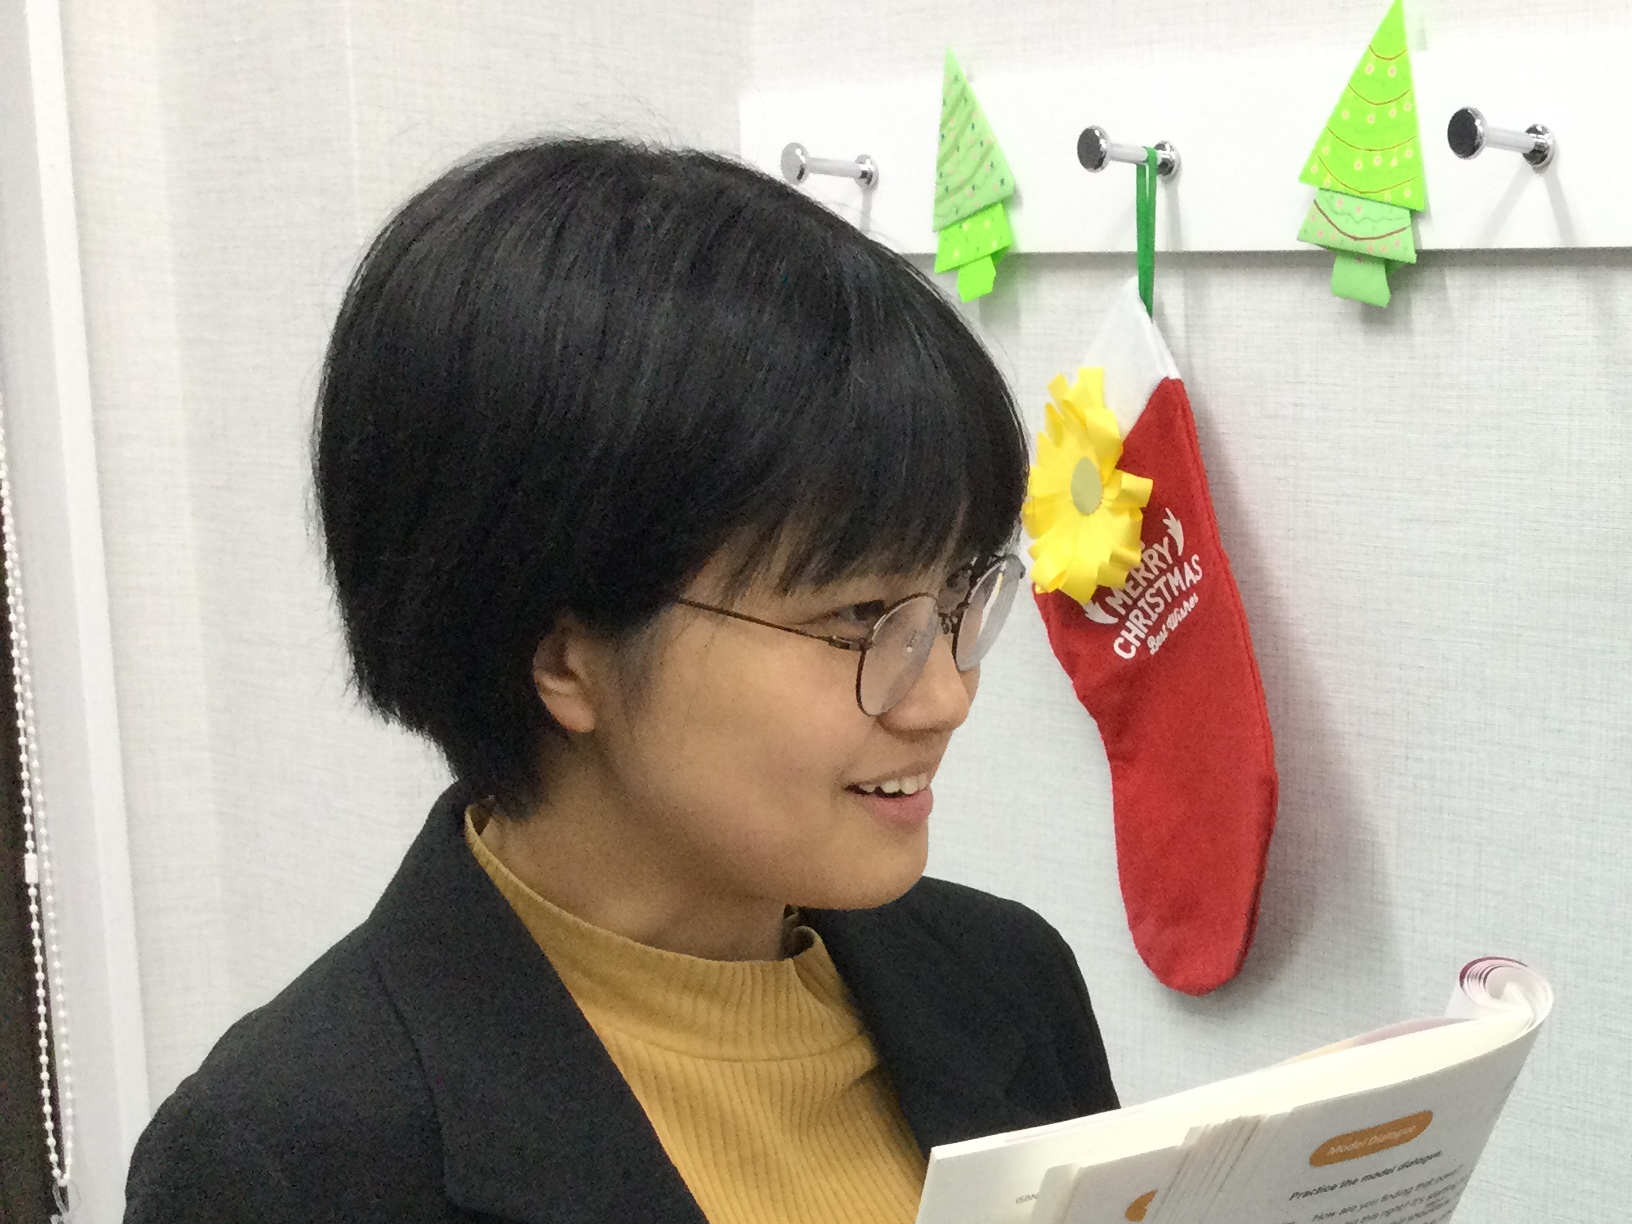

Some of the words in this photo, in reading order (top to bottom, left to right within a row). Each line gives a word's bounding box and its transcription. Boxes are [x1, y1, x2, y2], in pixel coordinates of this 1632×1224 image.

[1105, 536, 1173, 615] MERRY
[1113, 554, 1202, 659] CHRISTMAS
[1147, 624, 1169, 655] Best
[1166, 592, 1199, 631] Wishes
[1289, 1184, 1338, 1201] Practice
[1340, 1178, 1360, 1189] the
[1360, 1166, 1397, 1183] model
